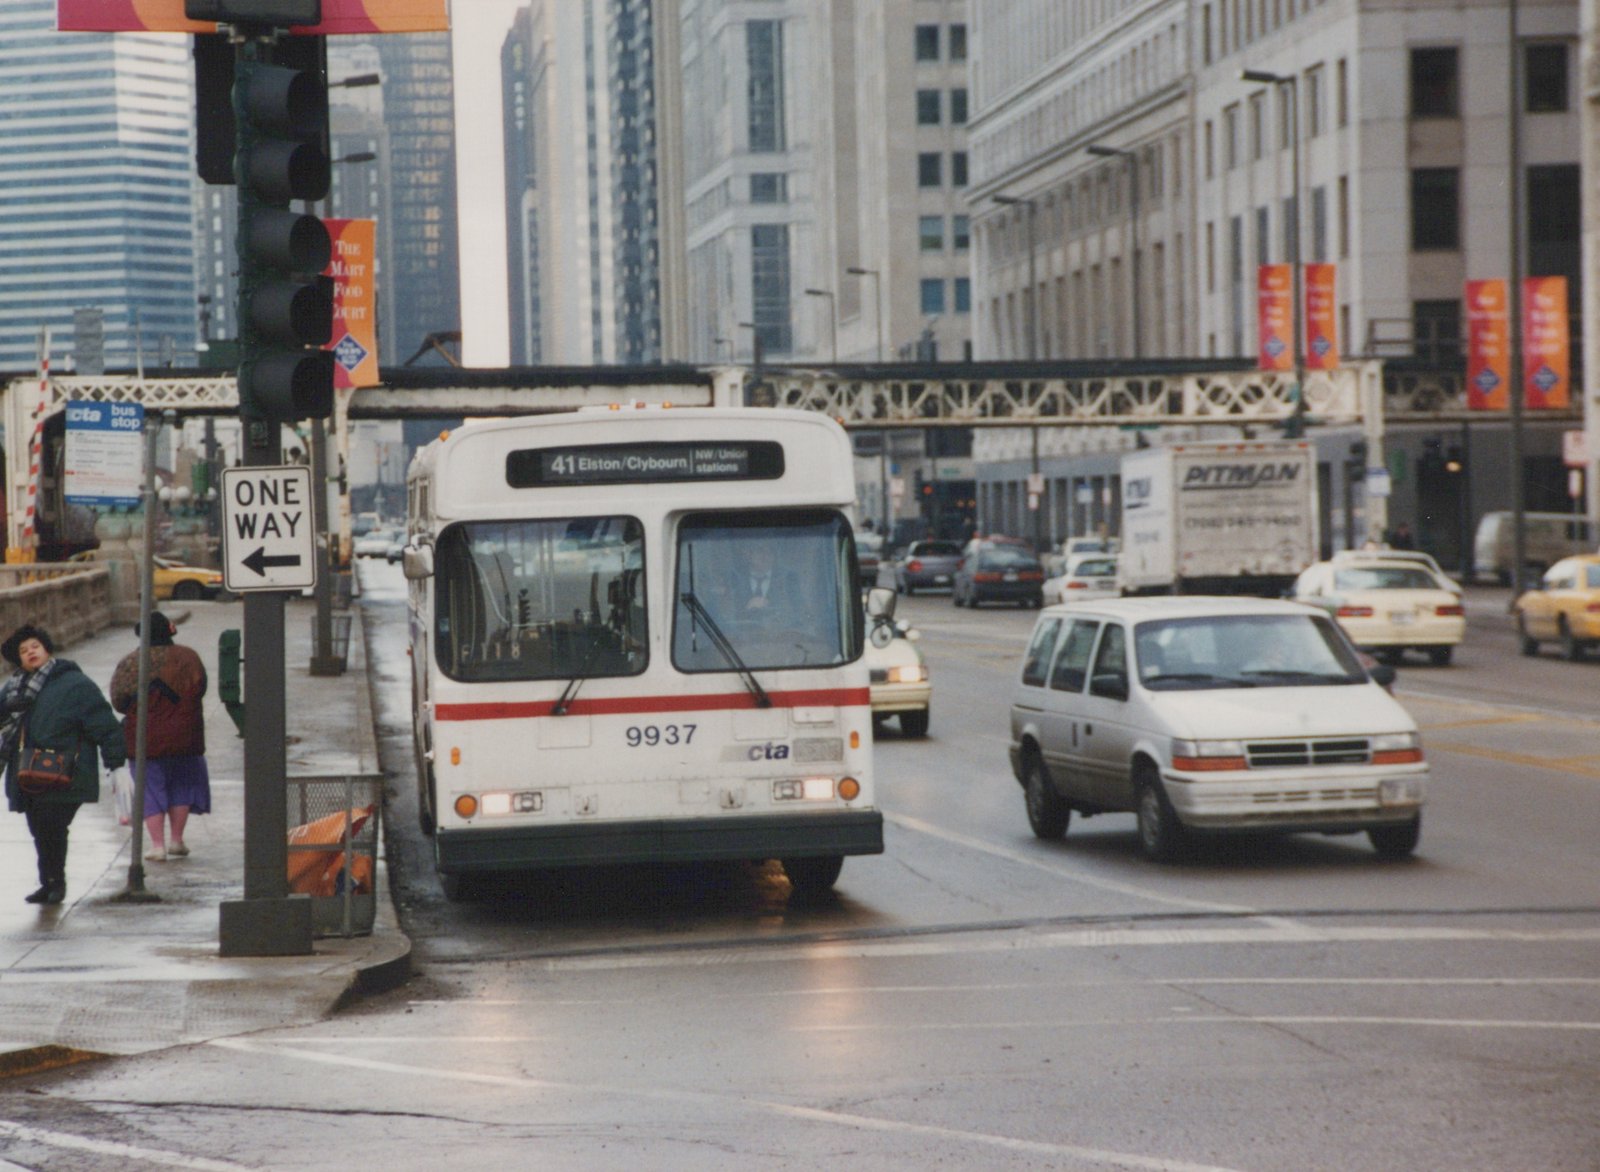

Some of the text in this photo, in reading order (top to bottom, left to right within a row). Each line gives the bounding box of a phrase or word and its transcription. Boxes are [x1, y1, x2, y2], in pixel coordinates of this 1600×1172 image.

[71, 407, 102, 422] cta
[111, 404, 136, 416] bus
[111, 416, 140, 430] stop
[551, 455, 688, 474] 41 Elston/Clybourn
[696, 462, 739, 473] stations
[1184, 462, 1302, 484] PITMAN
[235, 478, 301, 506] ONE
[235, 512, 302, 539] WAY
[626, 724, 697, 747] 9937
[748, 742, 790, 761] cta
